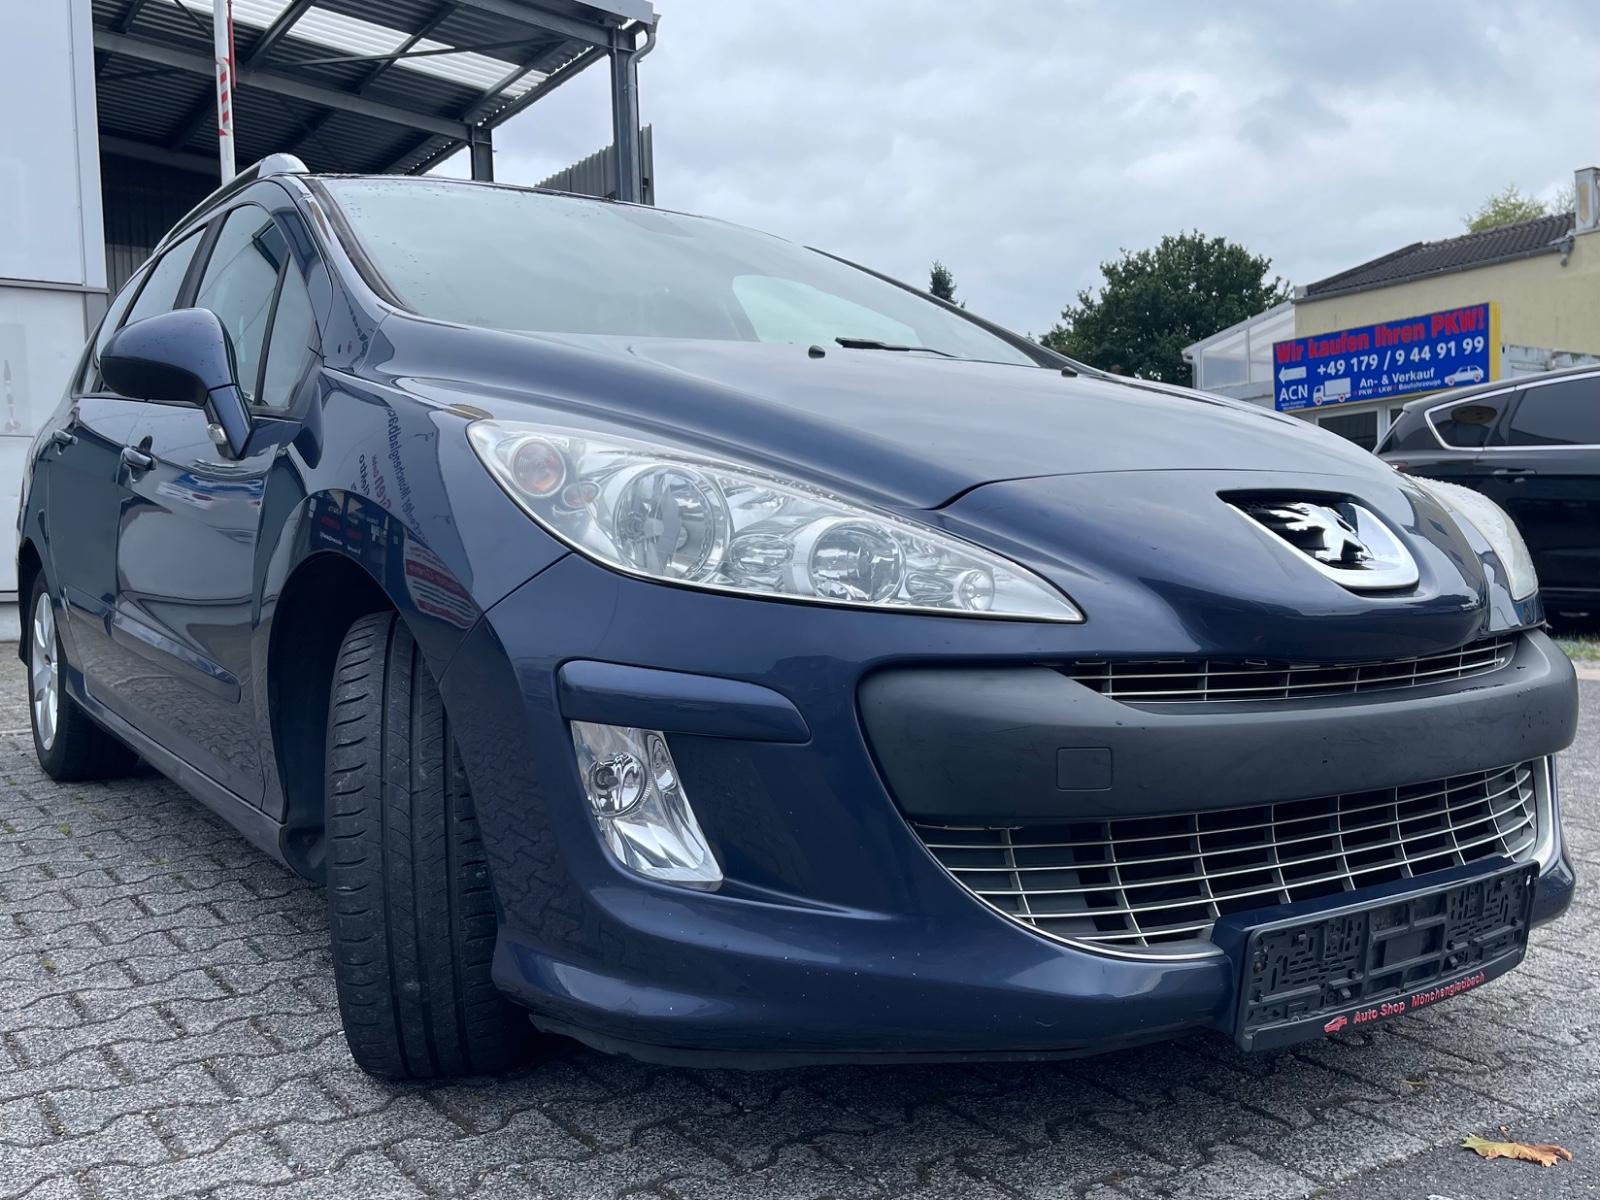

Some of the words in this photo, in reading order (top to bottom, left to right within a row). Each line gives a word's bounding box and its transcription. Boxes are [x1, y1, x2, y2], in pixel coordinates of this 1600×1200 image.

[1277, 342, 1303, 364] Wir
[1308, 332, 1370, 358] kaufen
[1375, 322, 1425, 348] Ihren
[1431, 306, 1485, 338] PKW!
[1317, 359, 1346, 377] +49
[1350, 353, 1378, 372] 179
[1383, 350, 1391, 370] /
[1395, 348, 1405, 365] 9
[1409, 344, 1431, 363] 44
[1437, 340, 1457, 359] 91
[1462, 335, 1485, 354] 99
[1279, 383, 1308, 402] ACN
[1358, 388, 1373, 397] PKW
[1359, 376, 1378, 389] An-
[1381, 374, 1389, 385] &
[1392, 366, 1435, 384] Verkauf
[1353, 1010, 1378, 1025] Auto
[1380, 1001, 1406, 1018] Shop
[1411, 971, 1485, 1006] Mönchengladbach
